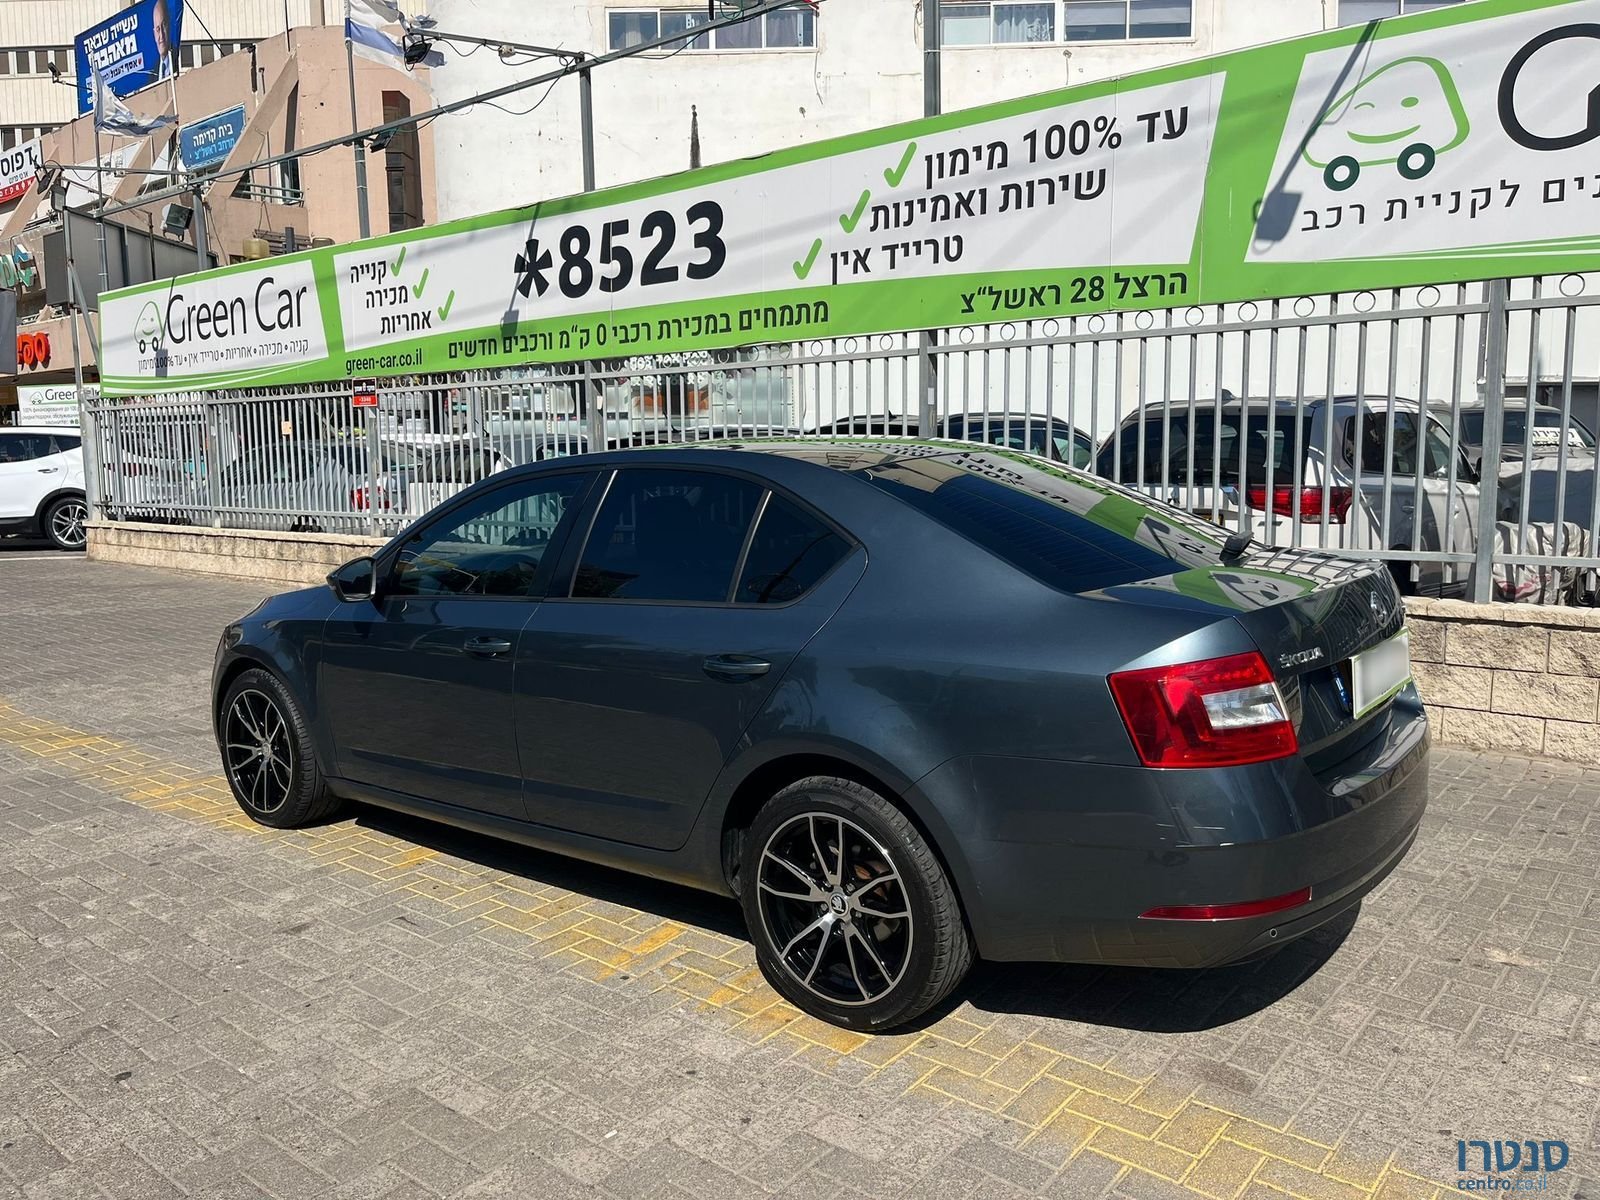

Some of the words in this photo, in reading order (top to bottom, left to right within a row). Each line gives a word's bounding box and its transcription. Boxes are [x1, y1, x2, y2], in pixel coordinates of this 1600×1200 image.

[110, 13, 138, 41] עשייה
[83, 29, 109, 54] שבאה
[218, 123, 233, 138] בית
[1136, 105, 1188, 143] עד
[1023, 115, 1121, 163] 100%
[0, 146, 33, 177] דפוס
[924, 140, 1008, 190] מימון
[999, 168, 1106, 213] שירות
[1384, 179, 1520, 222] לקניית
[869, 187, 988, 232] ואמינות
[1301, 204, 1366, 232] רכב
[882, 234, 964, 270] טרייד
[350, 260, 387, 285] קנייה
[830, 247, 872, 285] אין
[365, 285, 408, 309] מכירה
[1070, 276, 1105, 302] 28
[1114, 271, 1188, 299] הרצל
[167, 293, 247, 344] Green
[254, 276, 307, 332] Car
[380, 310, 432, 335] אחריות
[738, 300, 829, 331] מתמחים
[596, 323, 607, 347] 0
[611, 322, 651, 345] רכבי
[657, 312, 732, 341] במכירת
[224, 345, 252, 361] אחריות
[258, 342, 283, 357] מכירה
[289, 339, 309, 356] קניה
[448, 337, 497, 359] חדשים
[502, 332, 553, 354] ורכבים
[155, 357, 174, 369] 100%
[174, 355, 183, 367] עד
[187, 353, 198, 368] אין
[199, 350, 219, 365] טרייד
[345, 348, 422, 375] green-car.co.il
